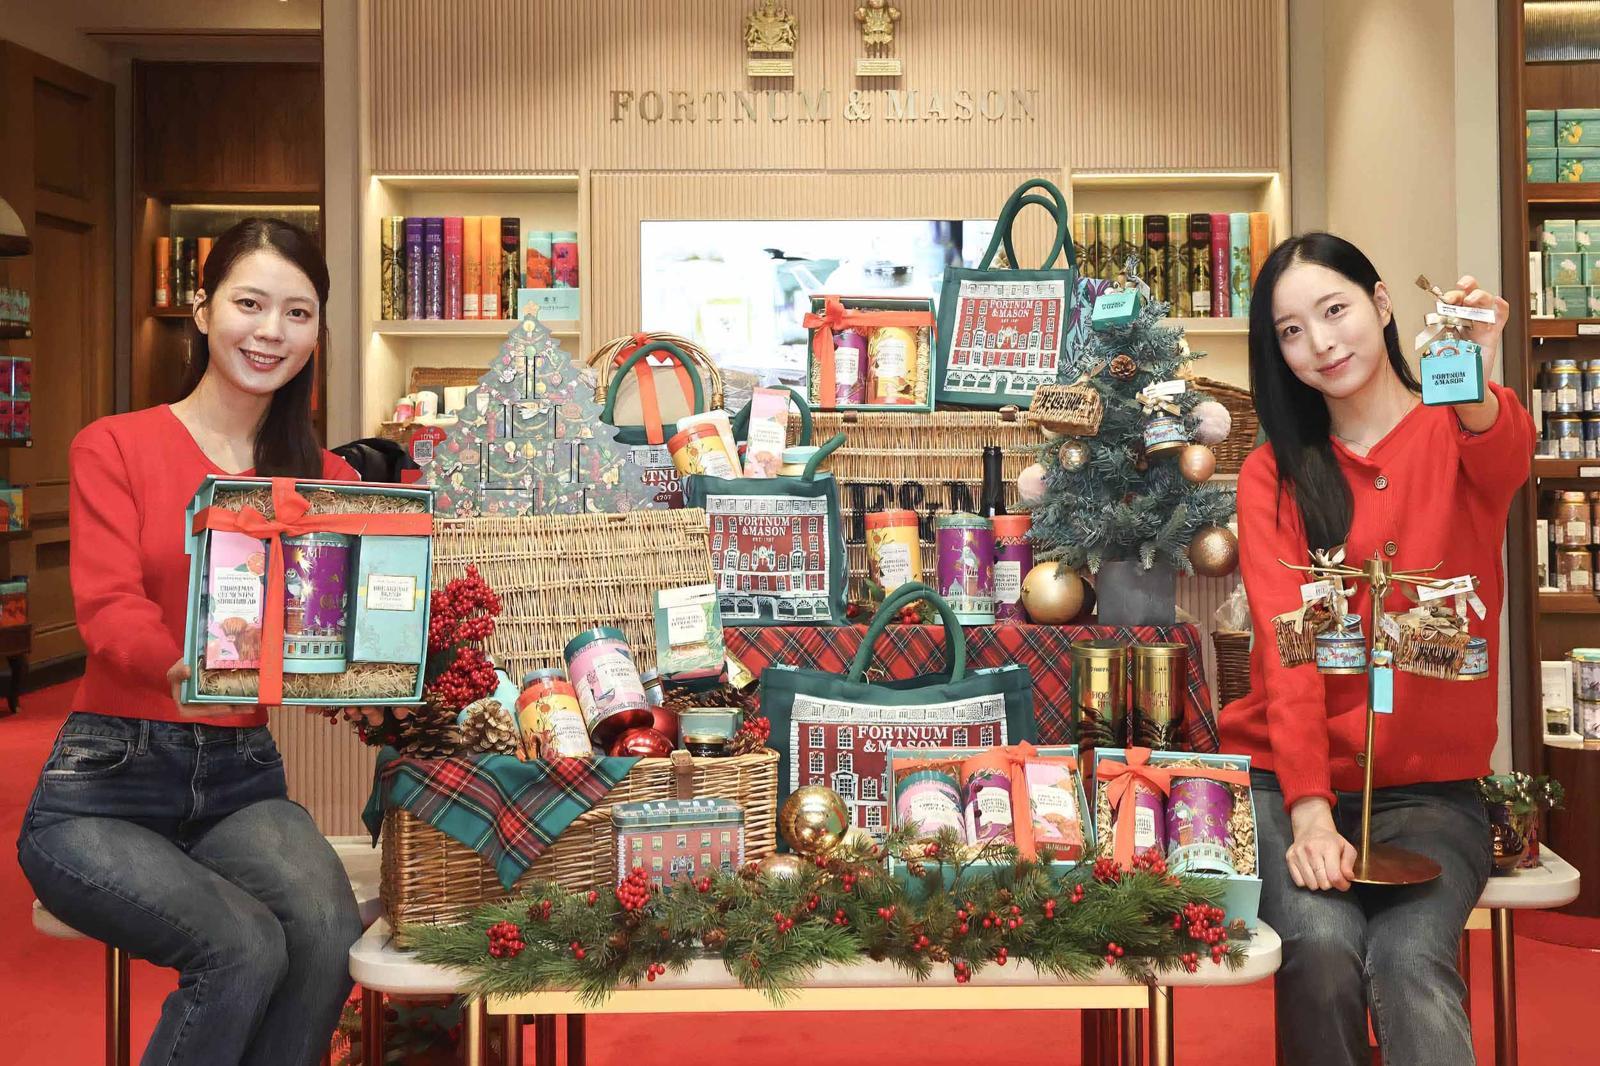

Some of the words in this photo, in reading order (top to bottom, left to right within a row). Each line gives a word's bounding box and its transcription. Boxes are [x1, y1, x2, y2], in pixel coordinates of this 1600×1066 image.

[610, 89, 832, 123] FORTNUM
[842, 90, 872, 123] &
[884, 89, 1040, 123] MASON
[989, 299, 1035, 310] FORTNUM
[1431, 371, 1466, 381] FORTNUM
[738, 516, 790, 527] FORTNUM
[741, 526, 787, 536] &MASON
[856, 725, 949, 740] FORTNUM
